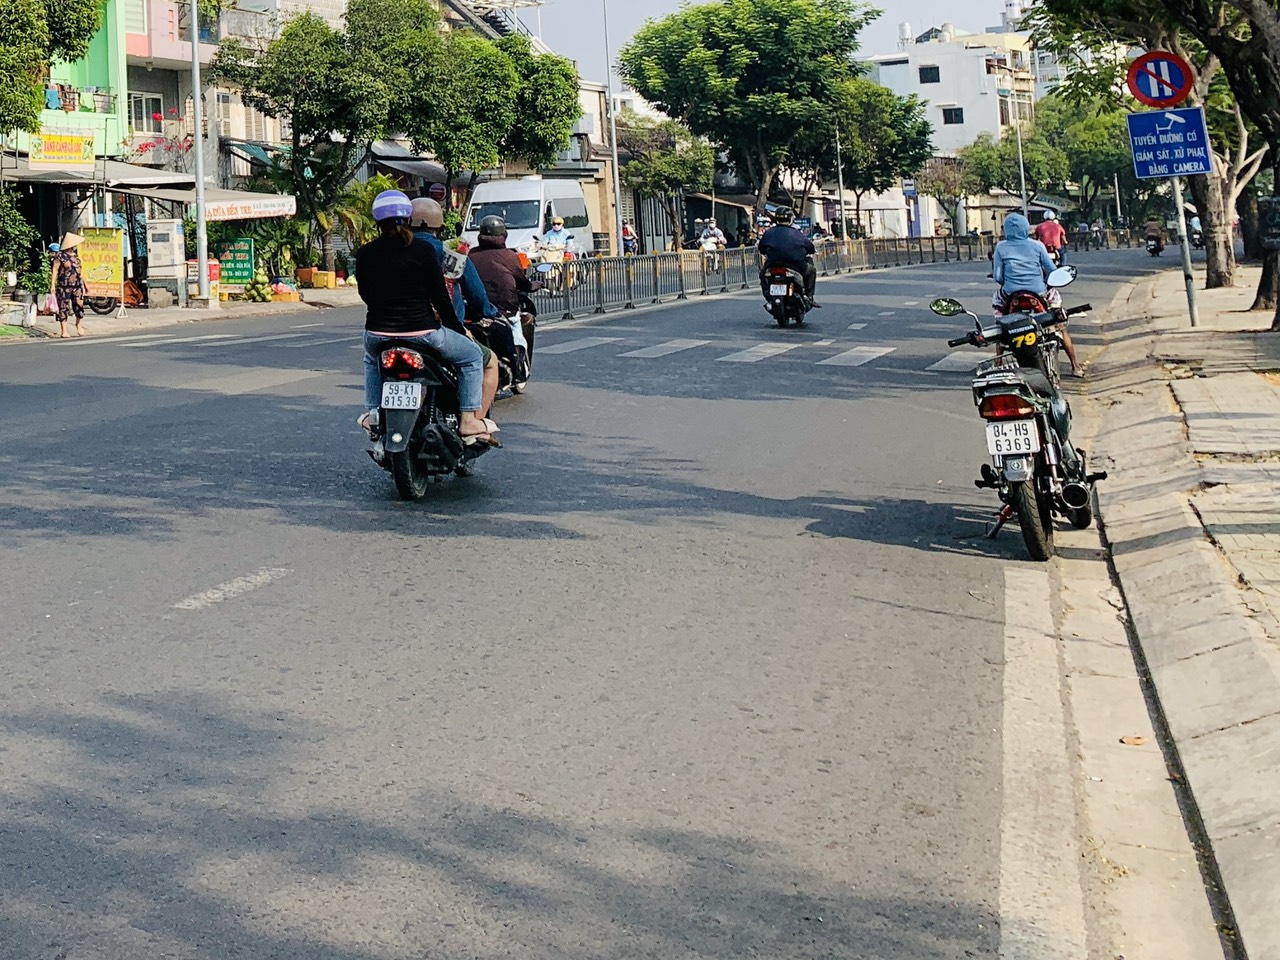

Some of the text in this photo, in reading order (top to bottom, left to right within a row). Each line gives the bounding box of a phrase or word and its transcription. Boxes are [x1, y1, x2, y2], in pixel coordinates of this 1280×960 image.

[1186, 129, 1197, 142] CÓ
[1135, 149, 1154, 162] GIÁM
[1173, 161, 1205, 173] CAMERA
[1012, 332, 1037, 348] 79
[388, 384, 414, 396] 59-K1
[384, 396, 418, 408] 815.39
[993, 423, 1029, 438] 84-H9
[995, 437, 1031, 452] 6369
